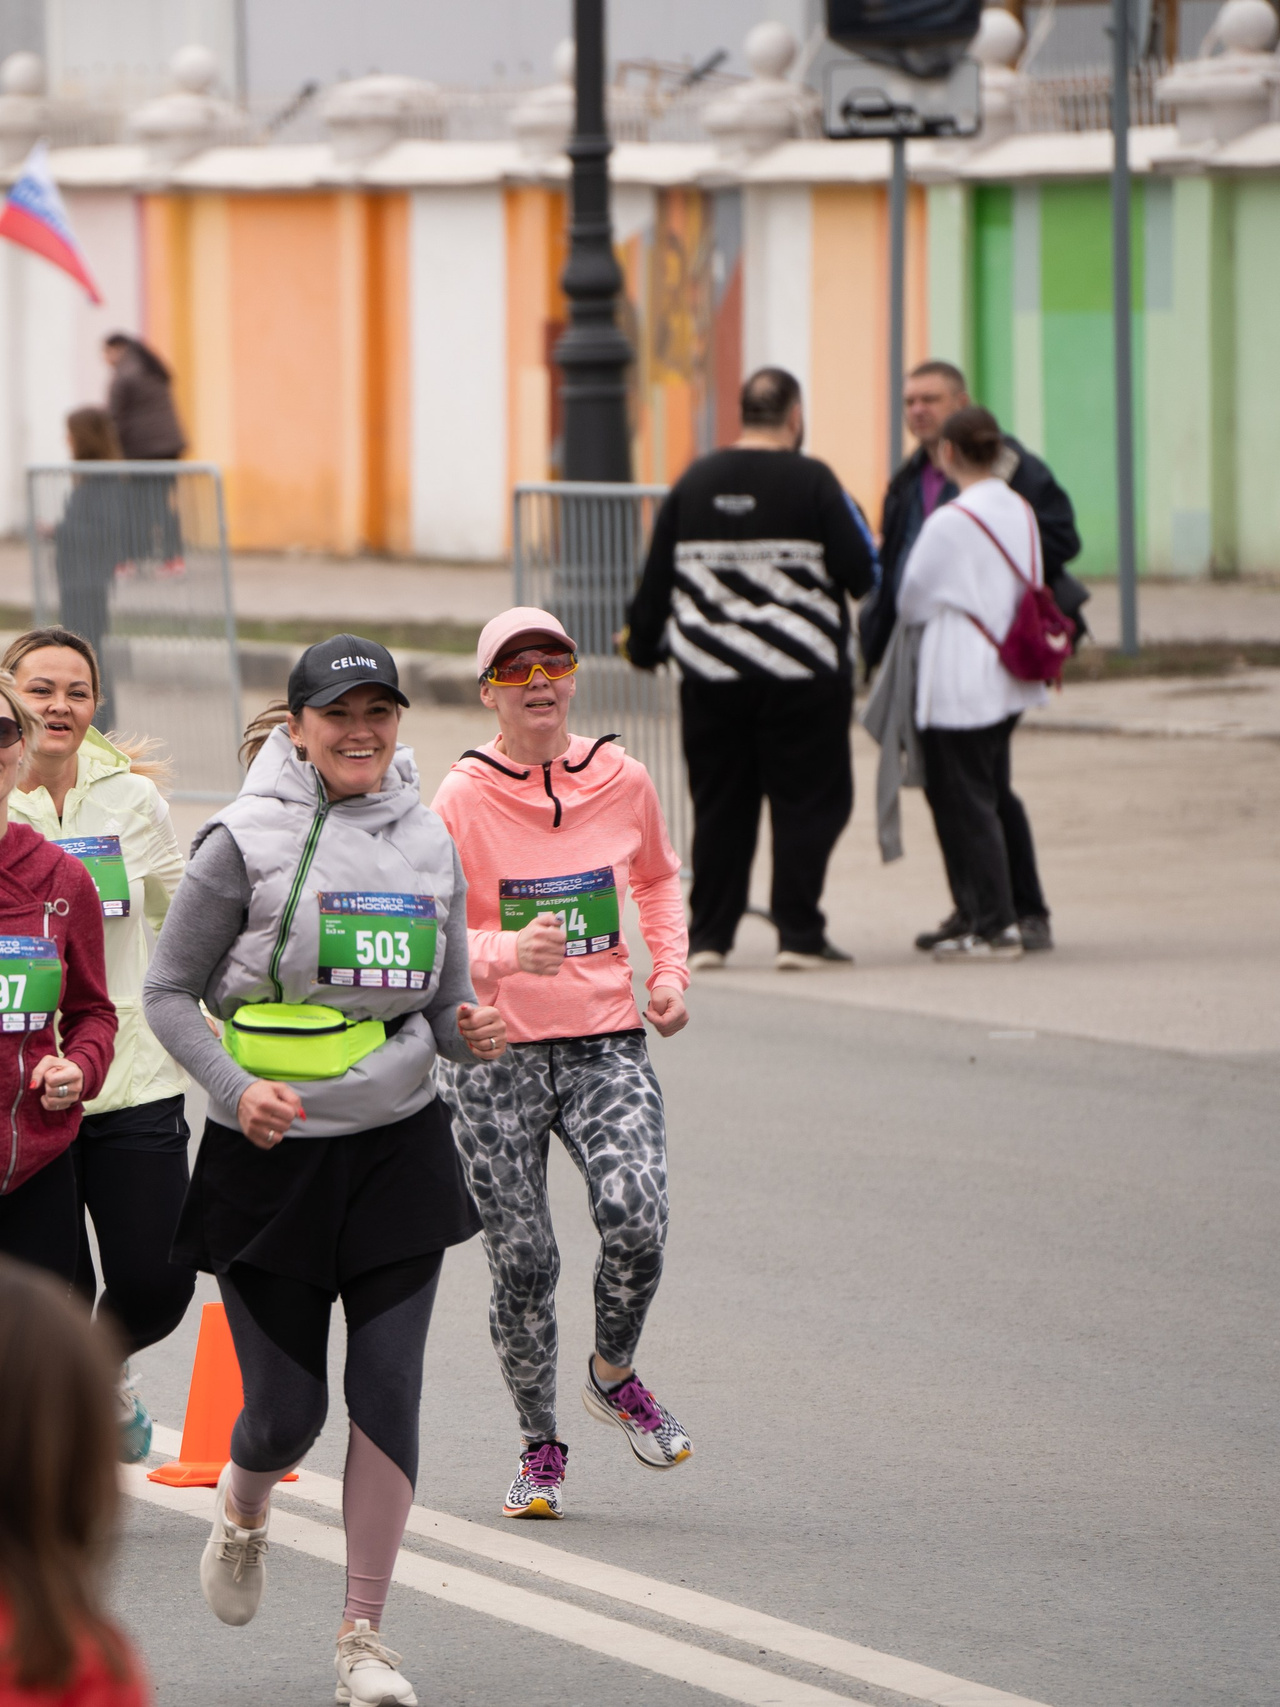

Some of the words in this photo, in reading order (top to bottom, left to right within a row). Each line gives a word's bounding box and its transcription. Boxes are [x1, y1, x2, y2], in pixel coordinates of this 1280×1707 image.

[331, 656, 378, 670] CELINE
[542, 878, 582, 888] ПРОСТО
[535, 884, 582, 895] КОСМОС
[536, 896, 578, 906] ЕКАТЕРИНА
[357, 903, 404, 912] КОСМОС
[538, 908, 588, 936] 14
[356, 930, 411, 966] 503
